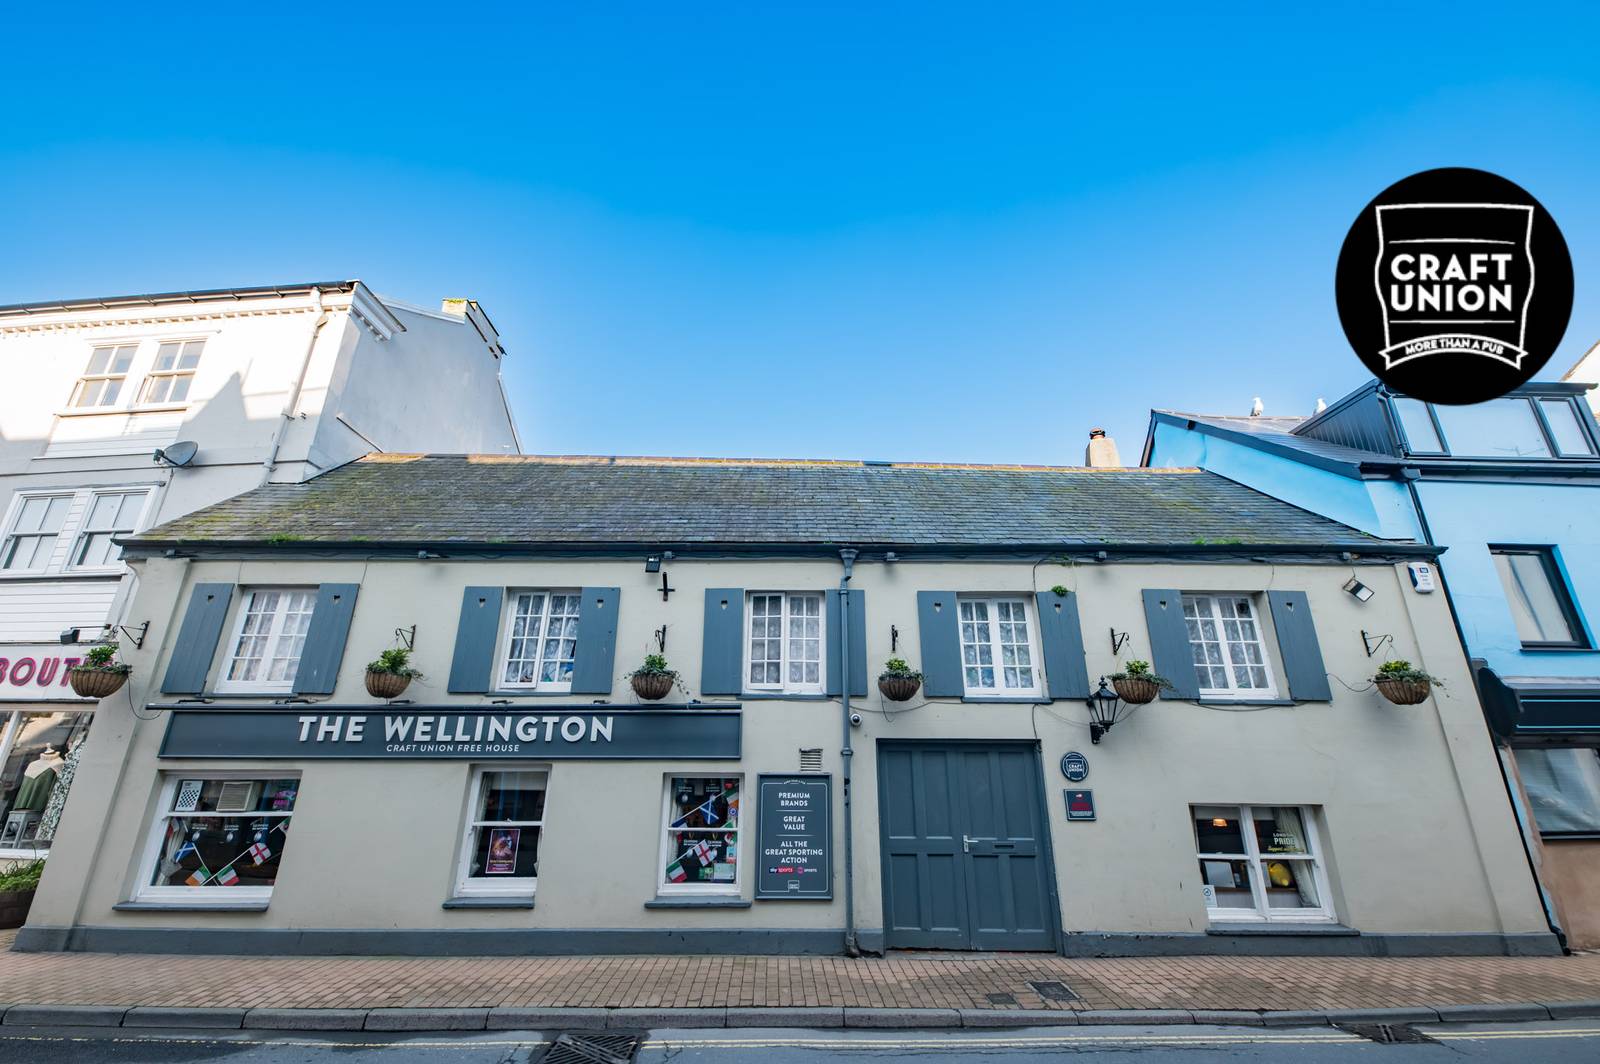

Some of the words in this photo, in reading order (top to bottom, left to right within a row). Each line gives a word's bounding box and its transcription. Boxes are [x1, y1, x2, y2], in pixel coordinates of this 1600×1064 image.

[298, 716, 367, 742] THE
[384, 715, 615, 743] WELLINGTON
[386, 744, 417, 753] CRAFT
[419, 744, 454, 753] UNION
[456, 744, 482, 753] FREE
[485, 744, 520, 753] HOUSE
